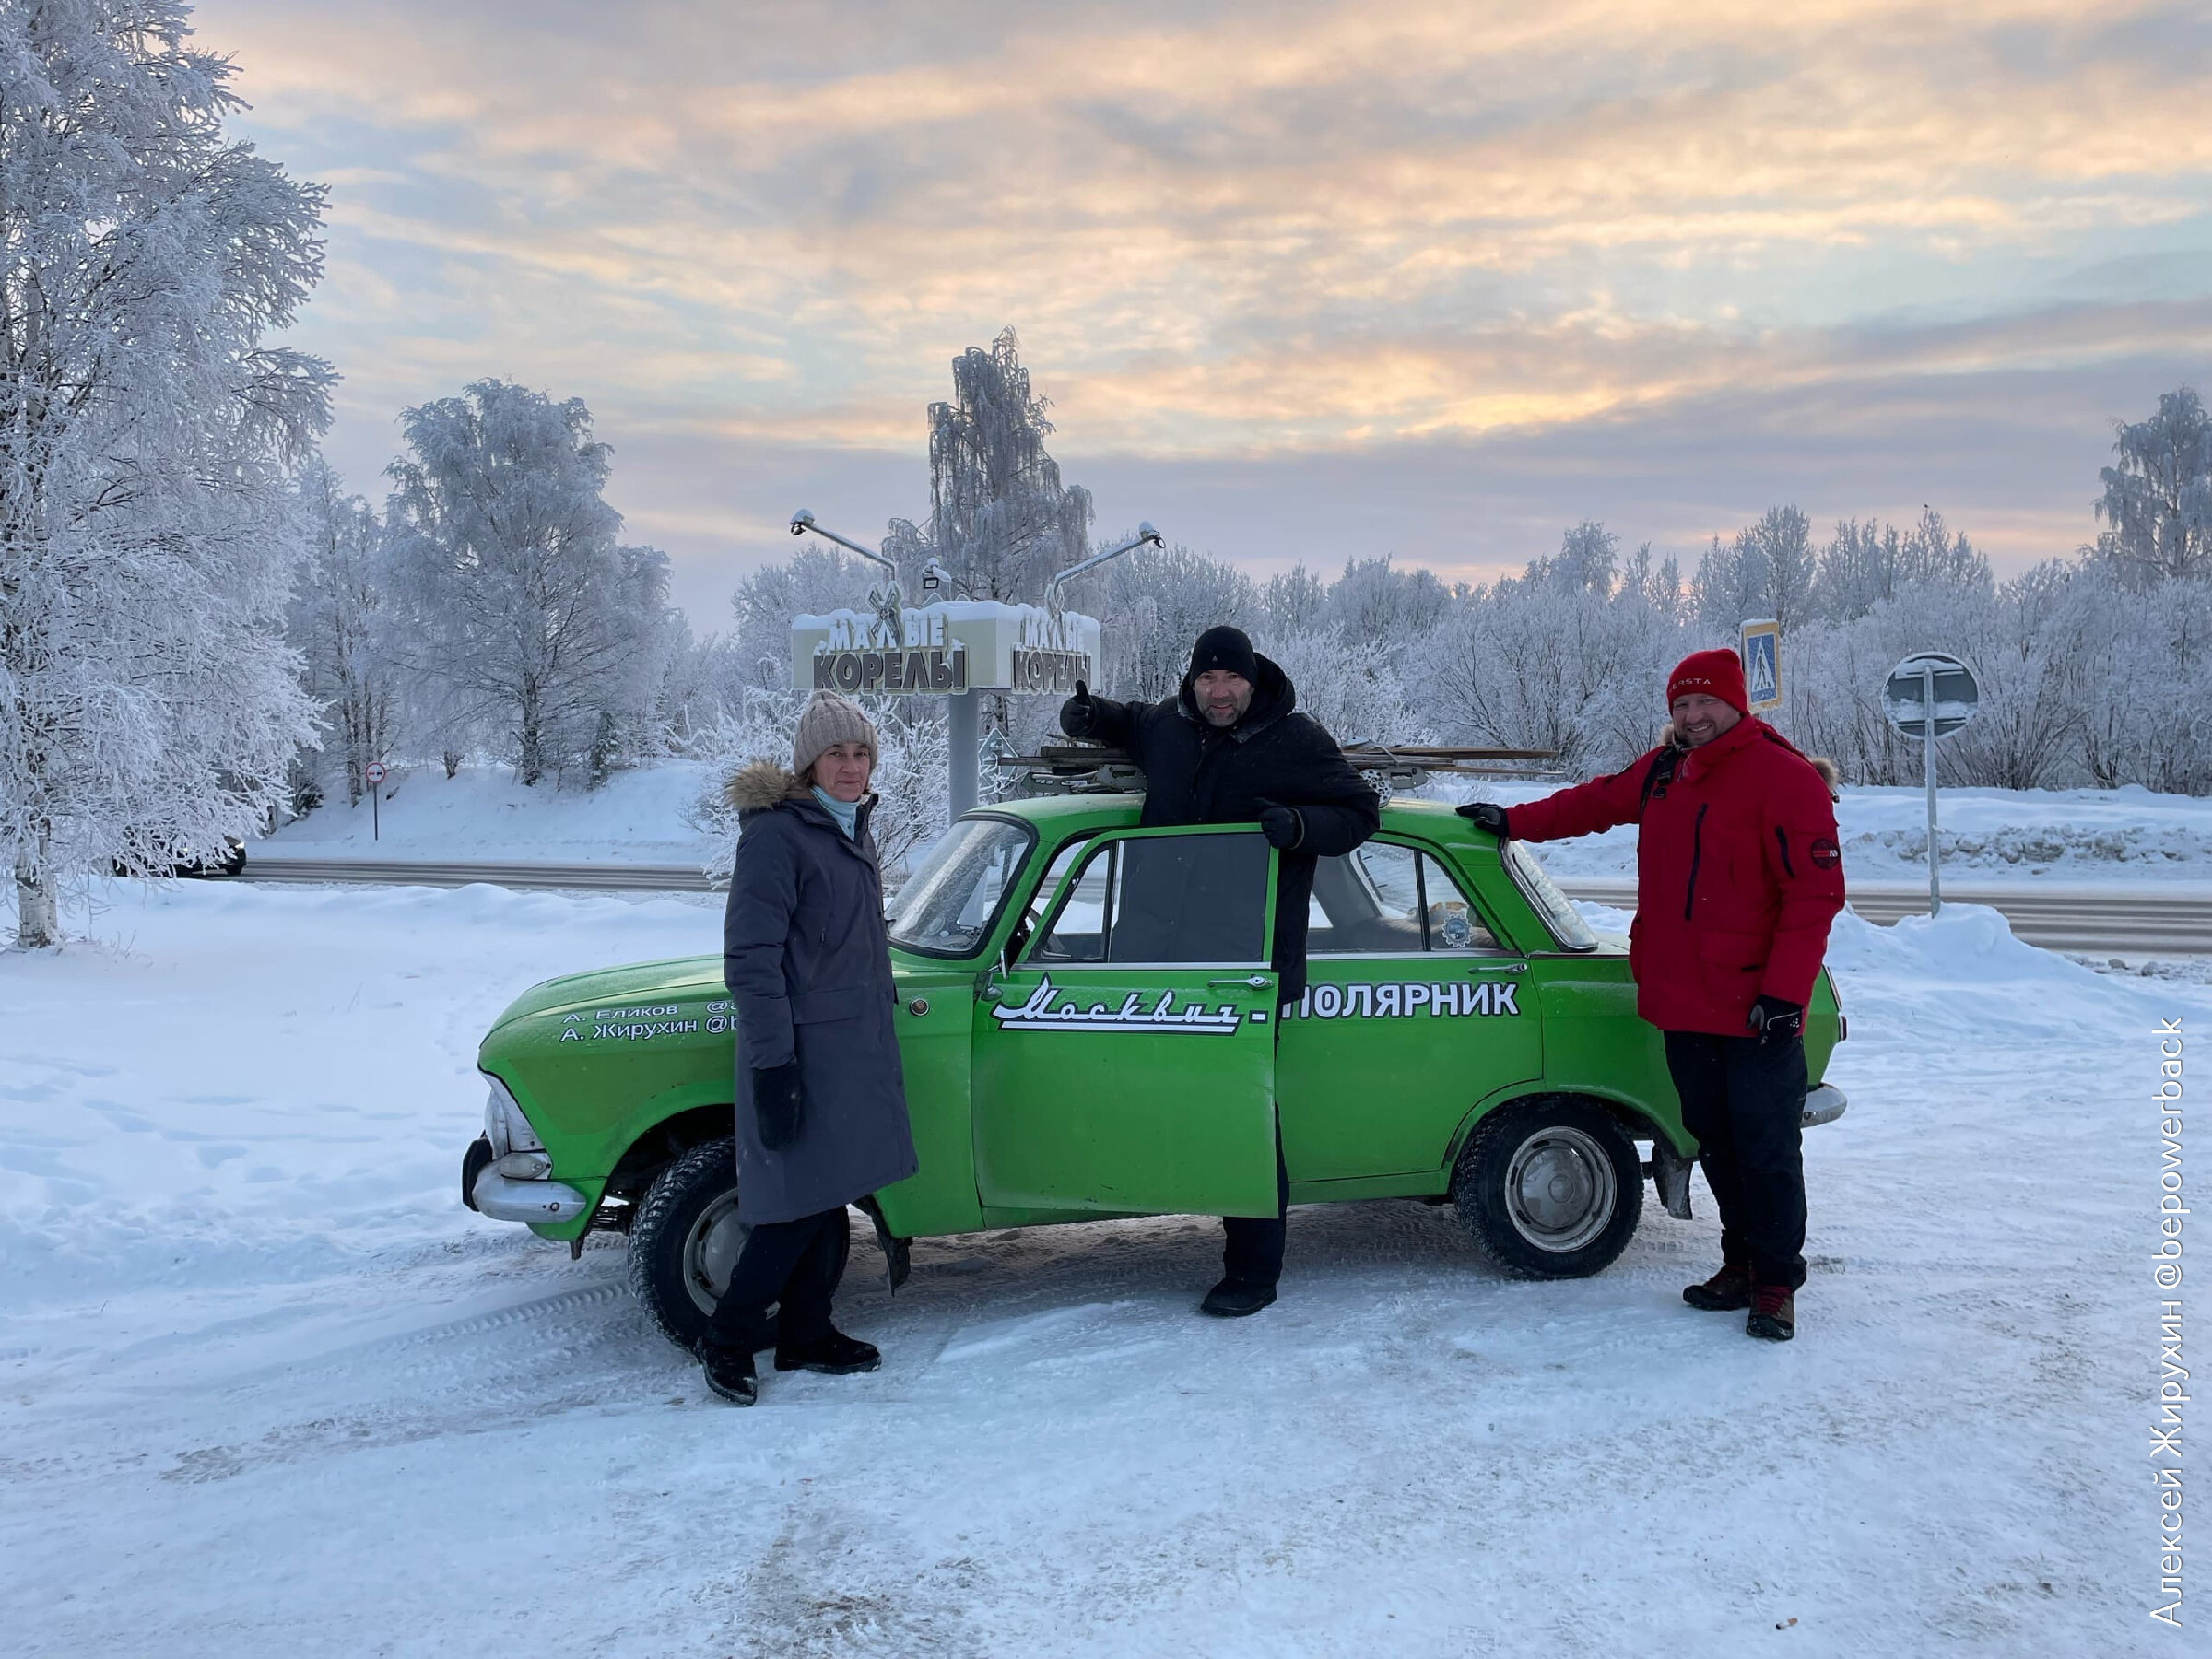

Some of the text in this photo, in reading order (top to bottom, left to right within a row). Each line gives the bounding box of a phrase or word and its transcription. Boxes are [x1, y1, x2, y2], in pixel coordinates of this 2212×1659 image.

[830, 614, 945, 651] МАЛЫЕ
[813, 647, 966, 690] КОРЕЛЫ
[562, 1013, 586, 1024] А.
[595, 1006, 678, 1019] Еликов
[559, 1028, 584, 1042] А.
[592, 1020, 698, 1041] Жирухин
